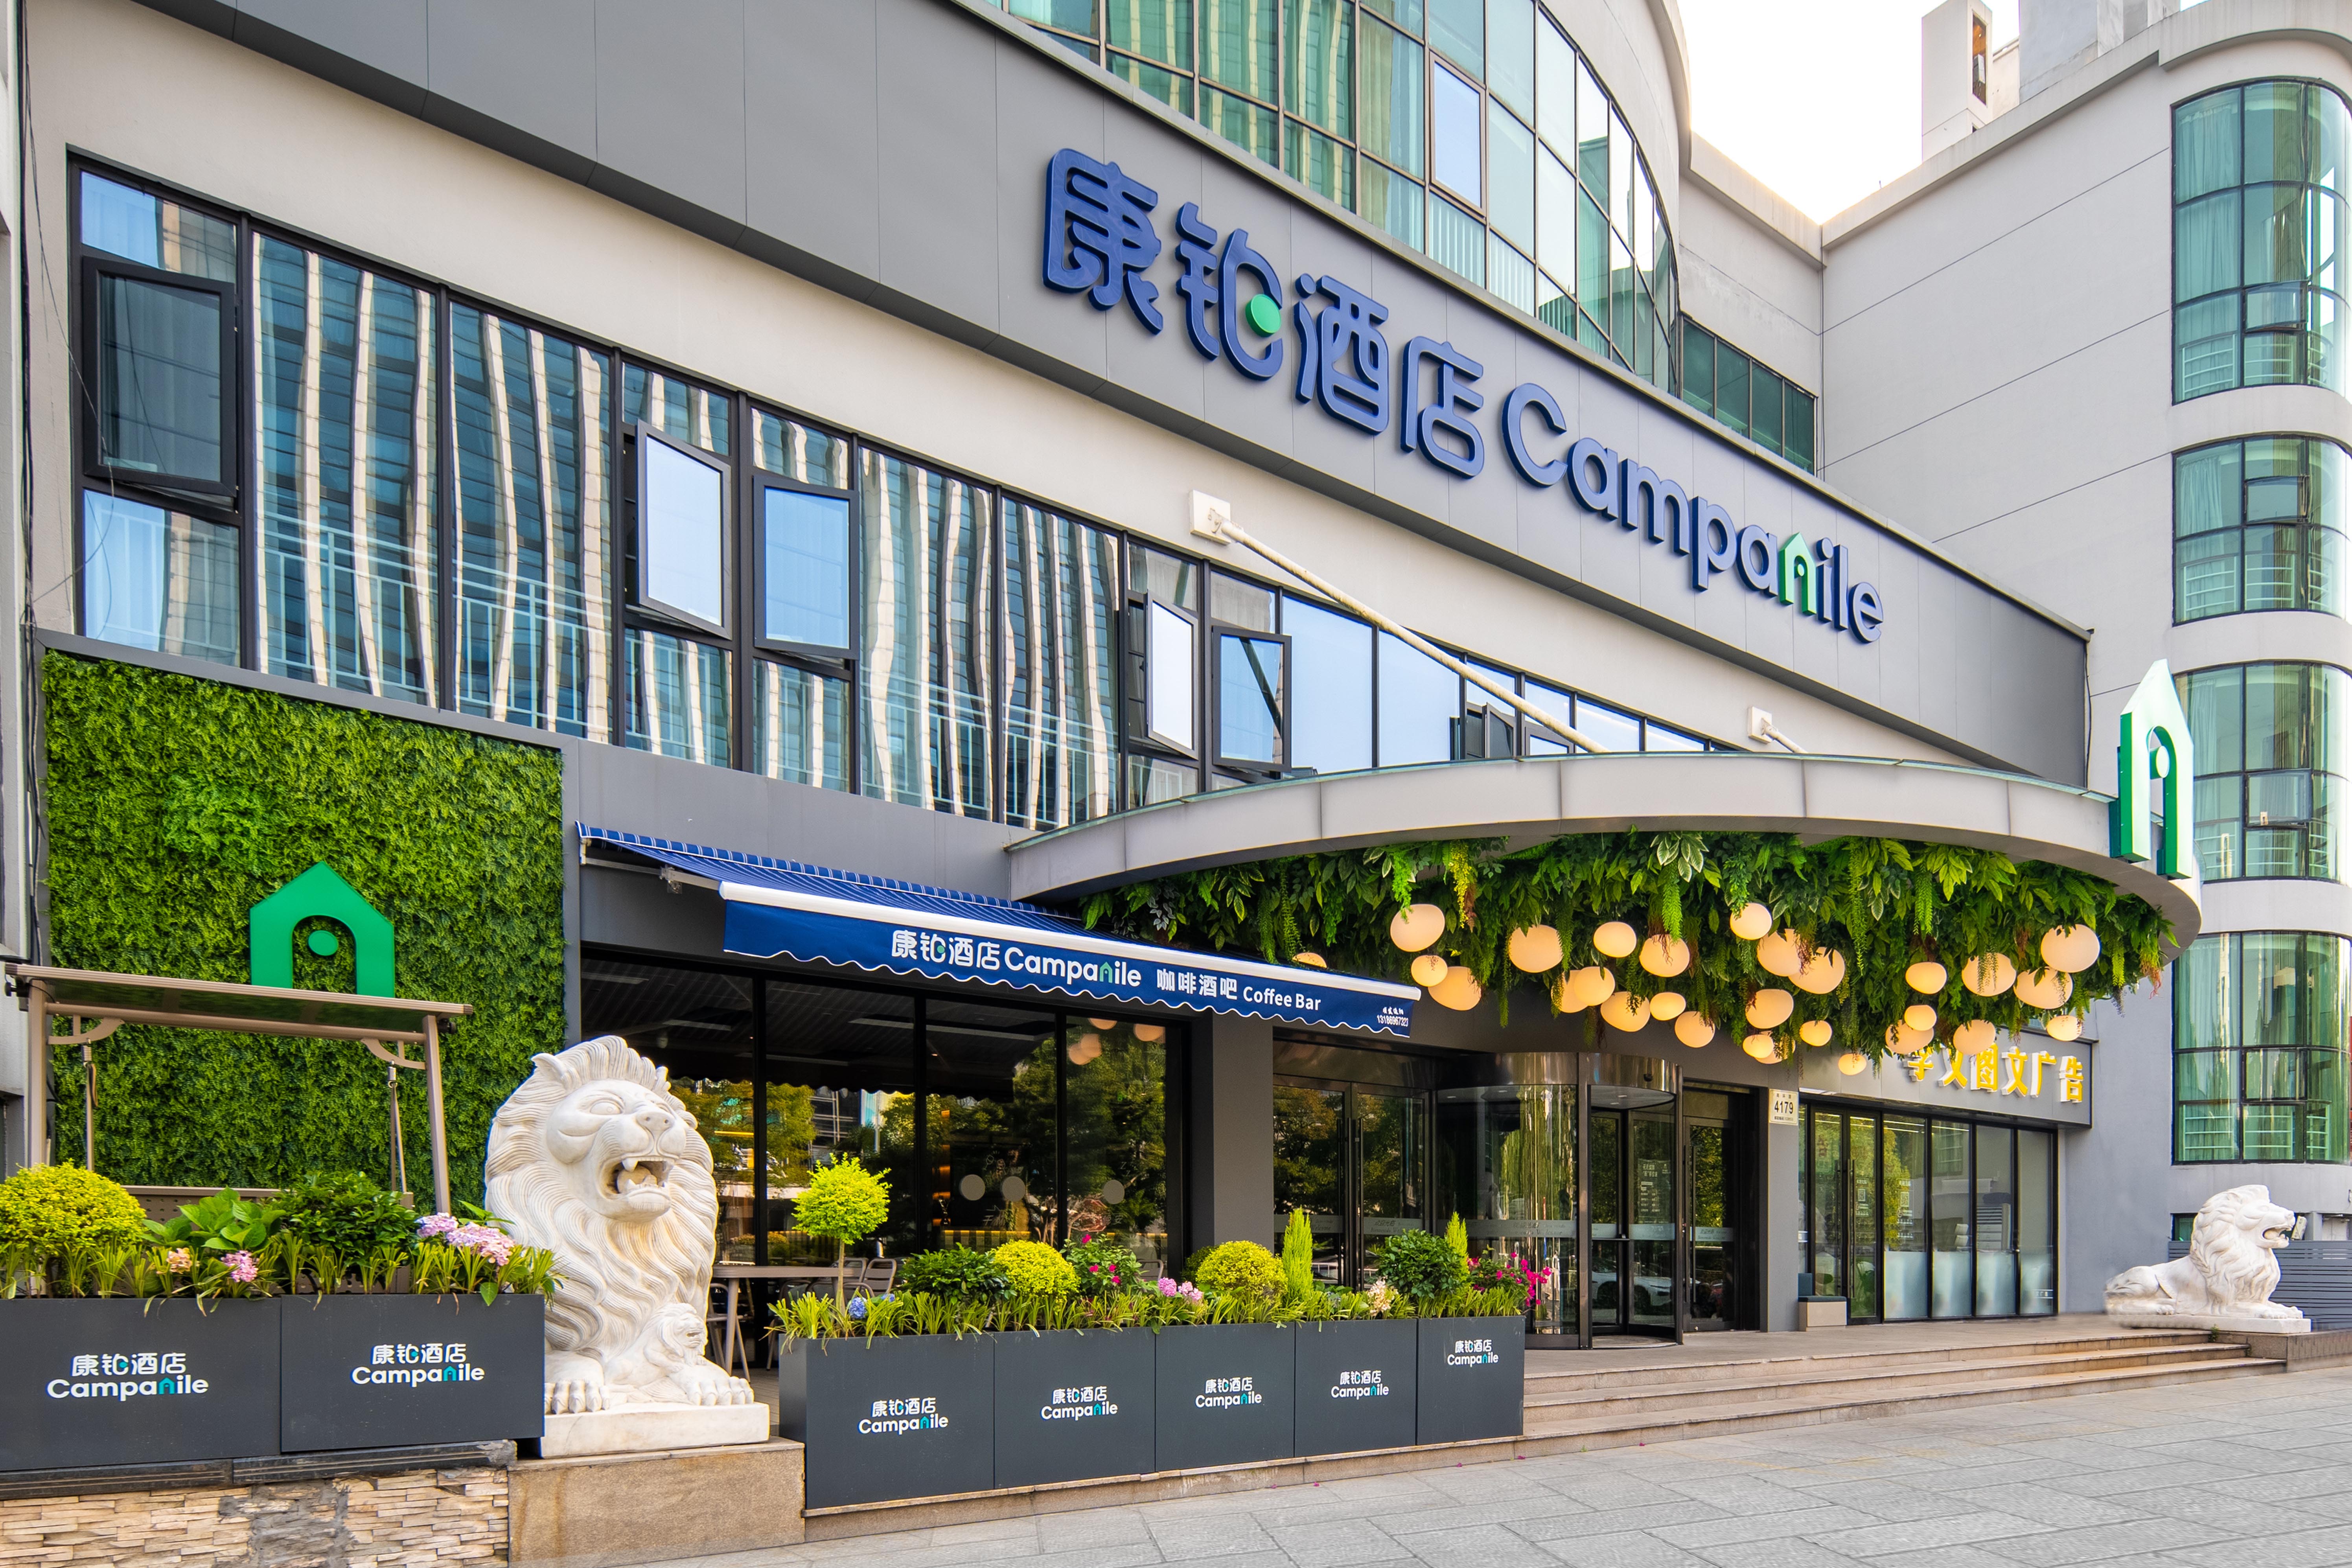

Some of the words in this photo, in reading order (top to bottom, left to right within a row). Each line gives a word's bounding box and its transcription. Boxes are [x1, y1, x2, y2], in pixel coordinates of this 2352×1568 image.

[1042, 147, 1485, 478] 康铂酒店
[1501, 382, 1885, 645] Campanile
[891, 929, 1000, 970] 康铂酒店
[1004, 947, 1142, 986] Campanile
[1156, 968, 1238, 1001] 咖啡酒吧
[1243, 986, 1292, 1007] Coffee
[1295, 993, 1321, 1011] Bar
[1774, 1101, 1794, 1114] 4179
[372, 1343, 467, 1365] 康铂酒店
[1455, 1339, 1492, 1353] 康铂酒店
[72, 1352, 187, 1377] 康铂酒店
[1447, 1351, 1499, 1368] Campanile
[351, 1363, 485, 1388] Campanile
[1205, 1377, 1253, 1394] 康铂酒店
[1340, 1370, 1382, 1385] 康铂酒店
[47, 1374, 209, 1402] Campanile
[1052, 1386, 1107, 1405] 康铂酒店
[1331, 1383, 1389, 1400] Campanile
[871, 1397, 936, 1417] 康铂酒店
[1195, 1390, 1262, 1410] Campanile
[1040, 1401, 1119, 1421] Campanile
[858, 1413, 949, 1435] Campanile
